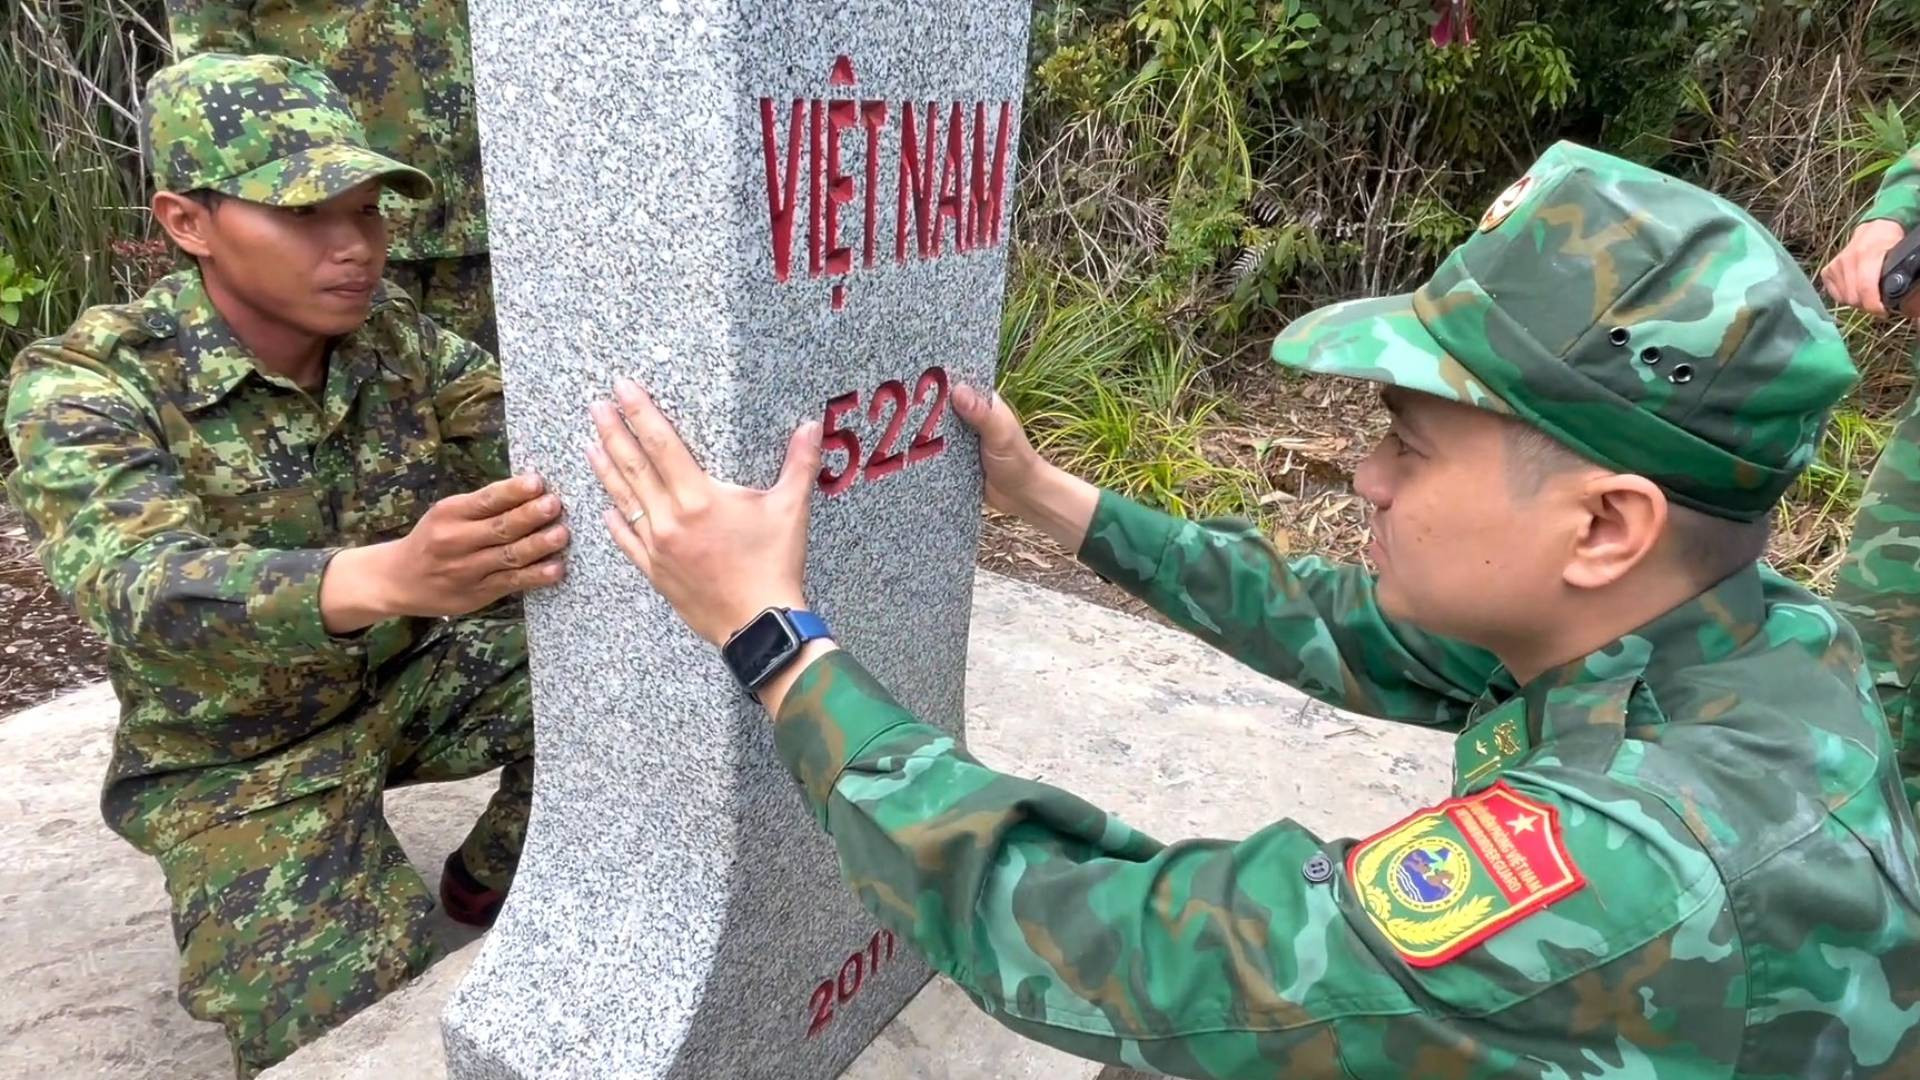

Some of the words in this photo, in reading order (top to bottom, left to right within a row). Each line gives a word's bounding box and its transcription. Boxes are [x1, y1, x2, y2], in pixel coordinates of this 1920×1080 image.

[760, 55, 888, 311] VIỆT
[896, 101, 1012, 263] NAM
[818, 366, 950, 497] 522
